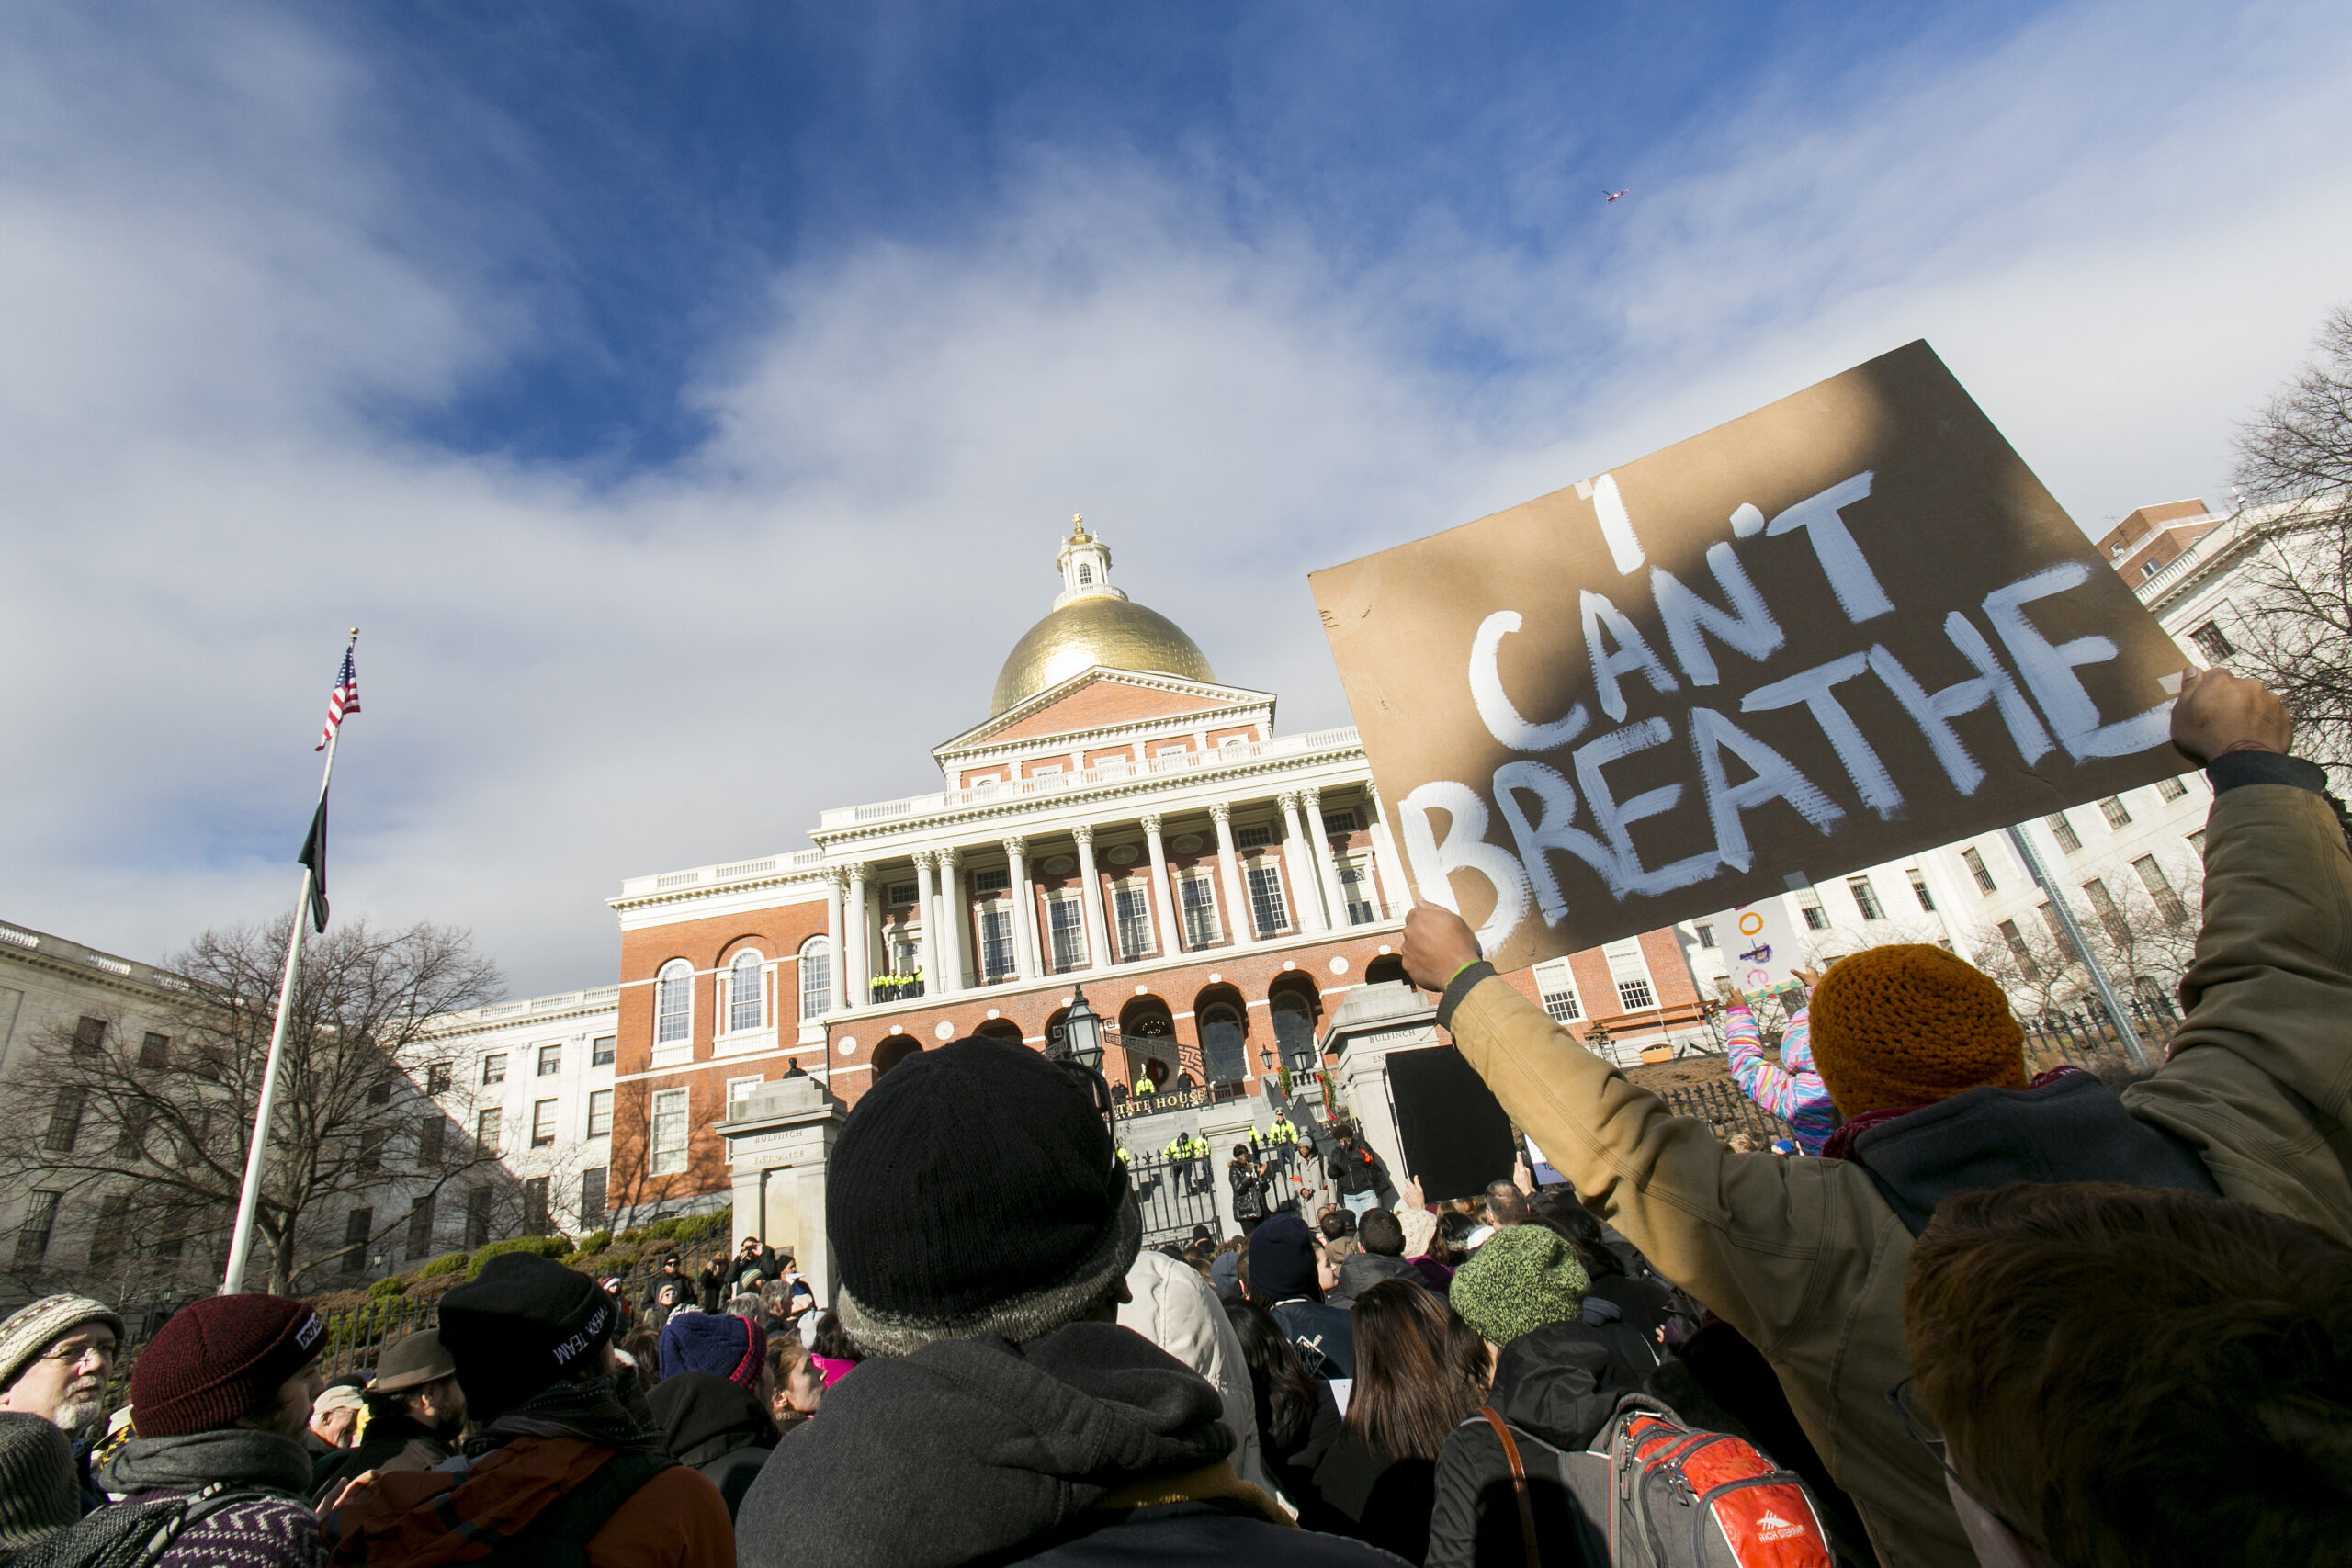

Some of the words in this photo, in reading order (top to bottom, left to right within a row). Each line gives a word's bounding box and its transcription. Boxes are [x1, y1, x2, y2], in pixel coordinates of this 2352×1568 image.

[1592, 473, 1646, 576] I
[1469, 469, 1895, 753] CAN'T
[1398, 561, 2175, 959] BREATHE
[1370, 1030, 1416, 1043] BULFINCH
[1156, 1091, 1205, 1108] HOUSE
[755, 1130, 802, 1143] BULFINCH
[552, 1331, 590, 1366] TEAM
[1758, 1531, 1778, 1542] HIGH
[1778, 1525, 1804, 1538] SIERRA
